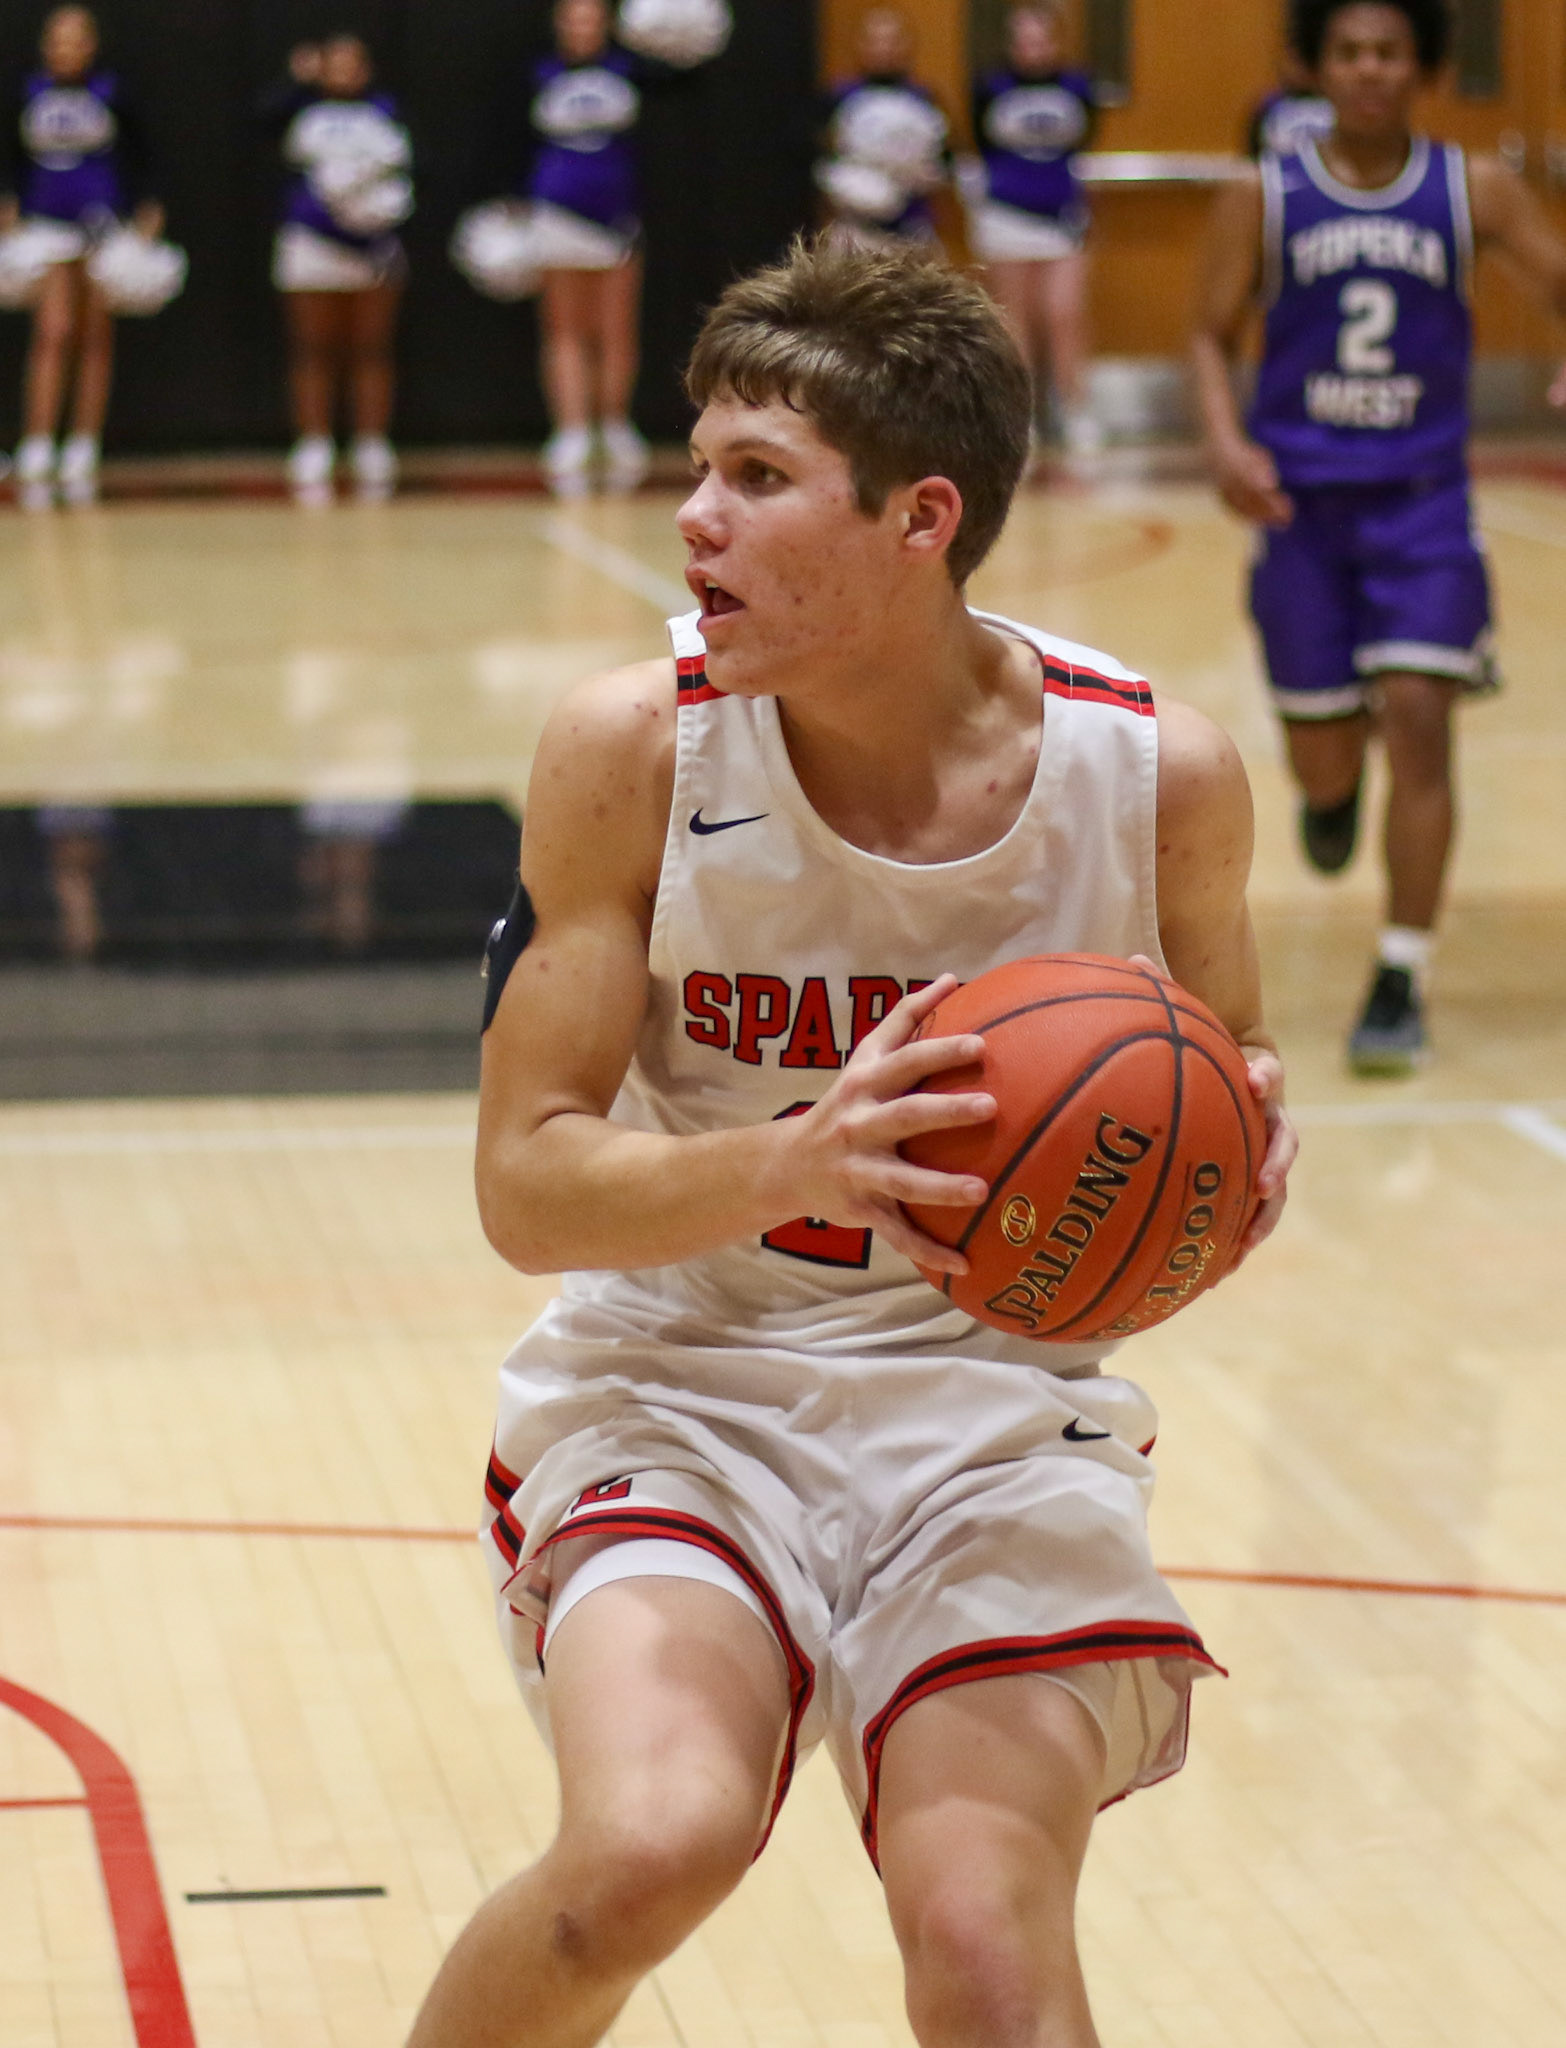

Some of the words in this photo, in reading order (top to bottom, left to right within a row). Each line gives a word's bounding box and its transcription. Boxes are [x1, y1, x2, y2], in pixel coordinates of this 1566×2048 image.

[1289, 215, 1448, 287] TOPEKA
[1338, 276, 1397, 375] 2
[1304, 372, 1424, 429] WEST
[683, 969, 966, 1069] SPAR
[983, 1111, 1154, 1330] SPALDING
